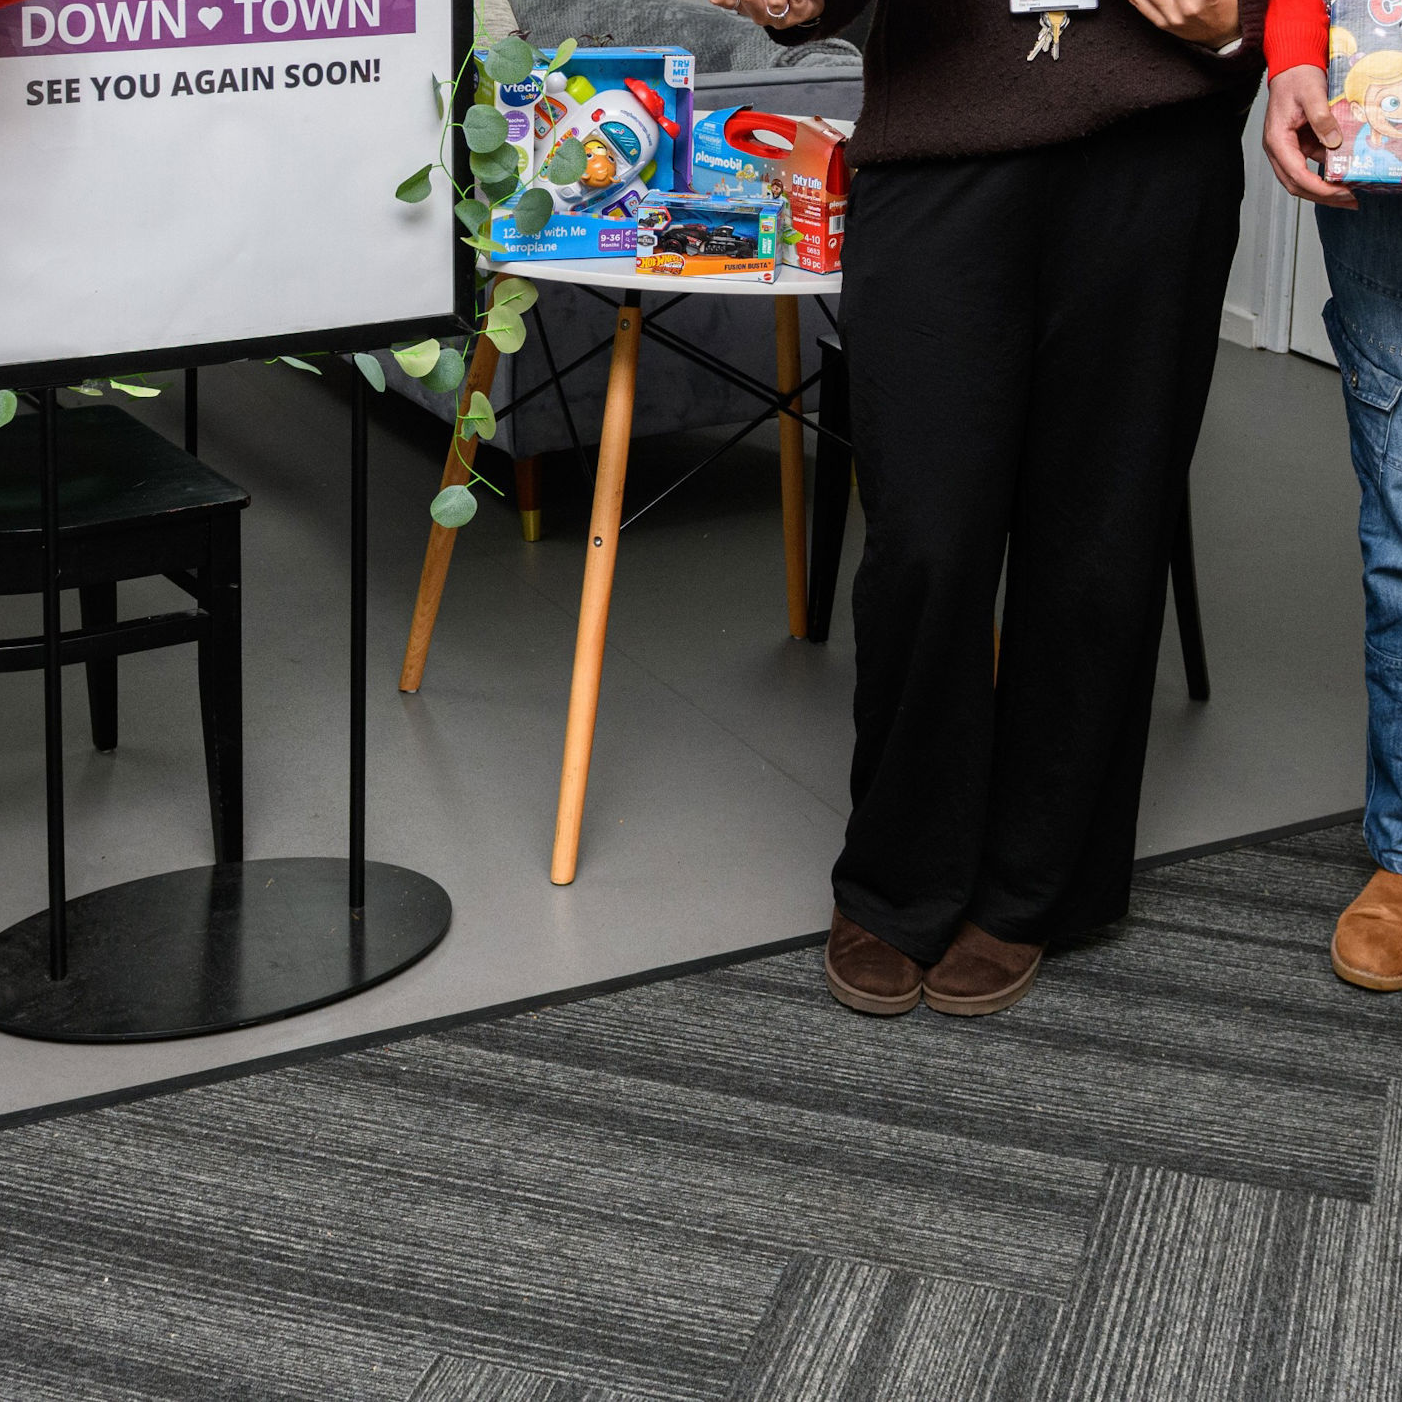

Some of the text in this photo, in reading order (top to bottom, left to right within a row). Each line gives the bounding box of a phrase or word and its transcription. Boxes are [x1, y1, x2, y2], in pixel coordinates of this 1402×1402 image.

[21, 0, 187, 47] DOWN
[672, 68, 688, 76] ME!
[26, 59, 381, 106] SEE YOU AGAIN SOON!
[503, 83, 540, 93] vtech
[695, 150, 742, 170] playmobil
[792, 174, 822, 189] City Life
[544, 227, 568, 238] with
[570, 226, 586, 237] Me
[600, 234, 620, 242] 9-36
[804, 233, 820, 245] 4-10
[801, 256, 821, 269] 39 pc
